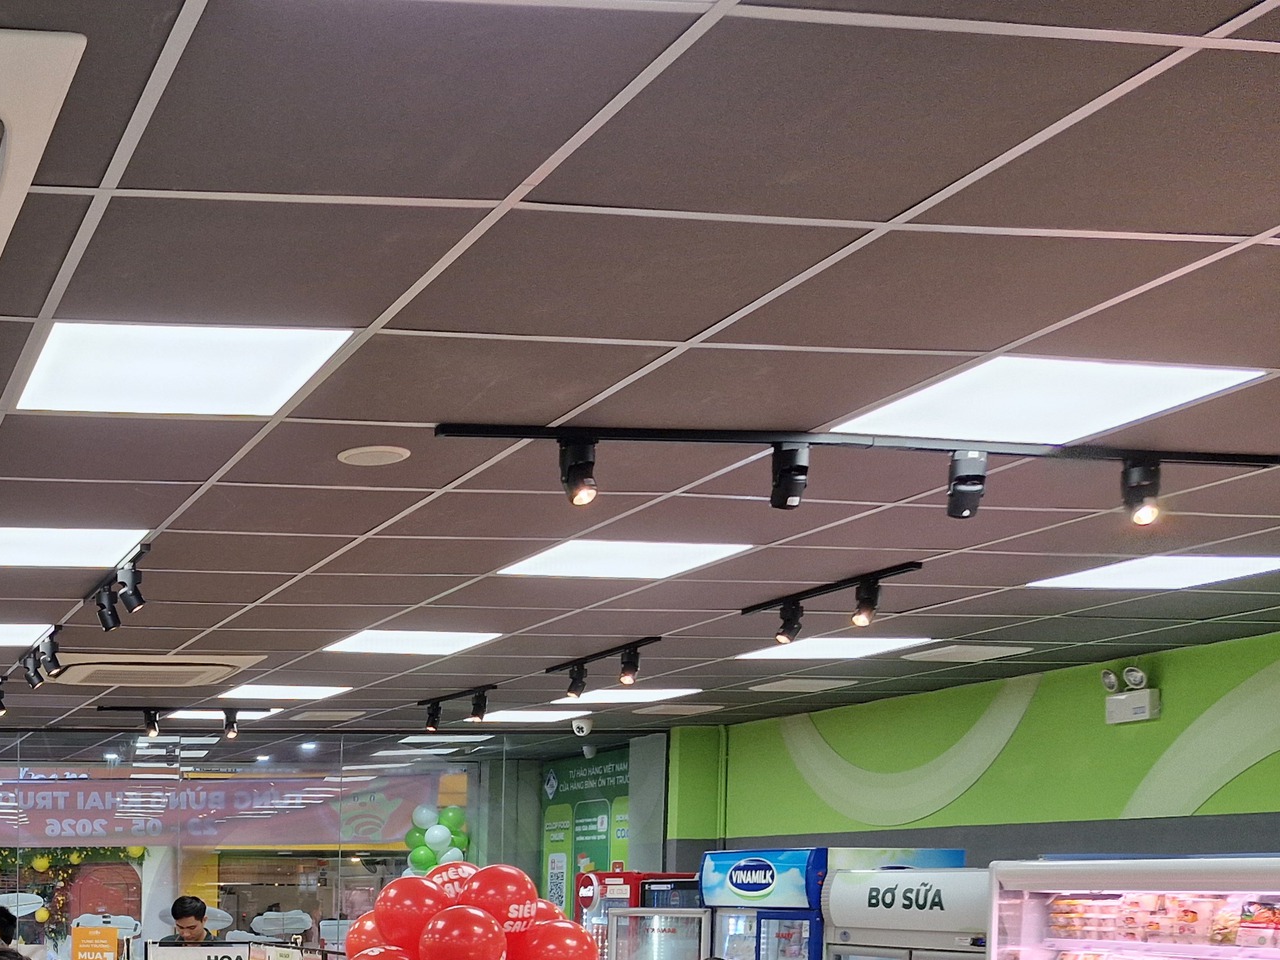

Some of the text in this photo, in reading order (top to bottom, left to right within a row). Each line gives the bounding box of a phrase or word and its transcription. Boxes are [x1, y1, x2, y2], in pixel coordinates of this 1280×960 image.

[732, 869, 773, 885] VINAMILK
[868, 883, 946, 911] BƠ SỮA
[508, 900, 537, 919] SIÊU
[78, 951, 103, 960] MUA
